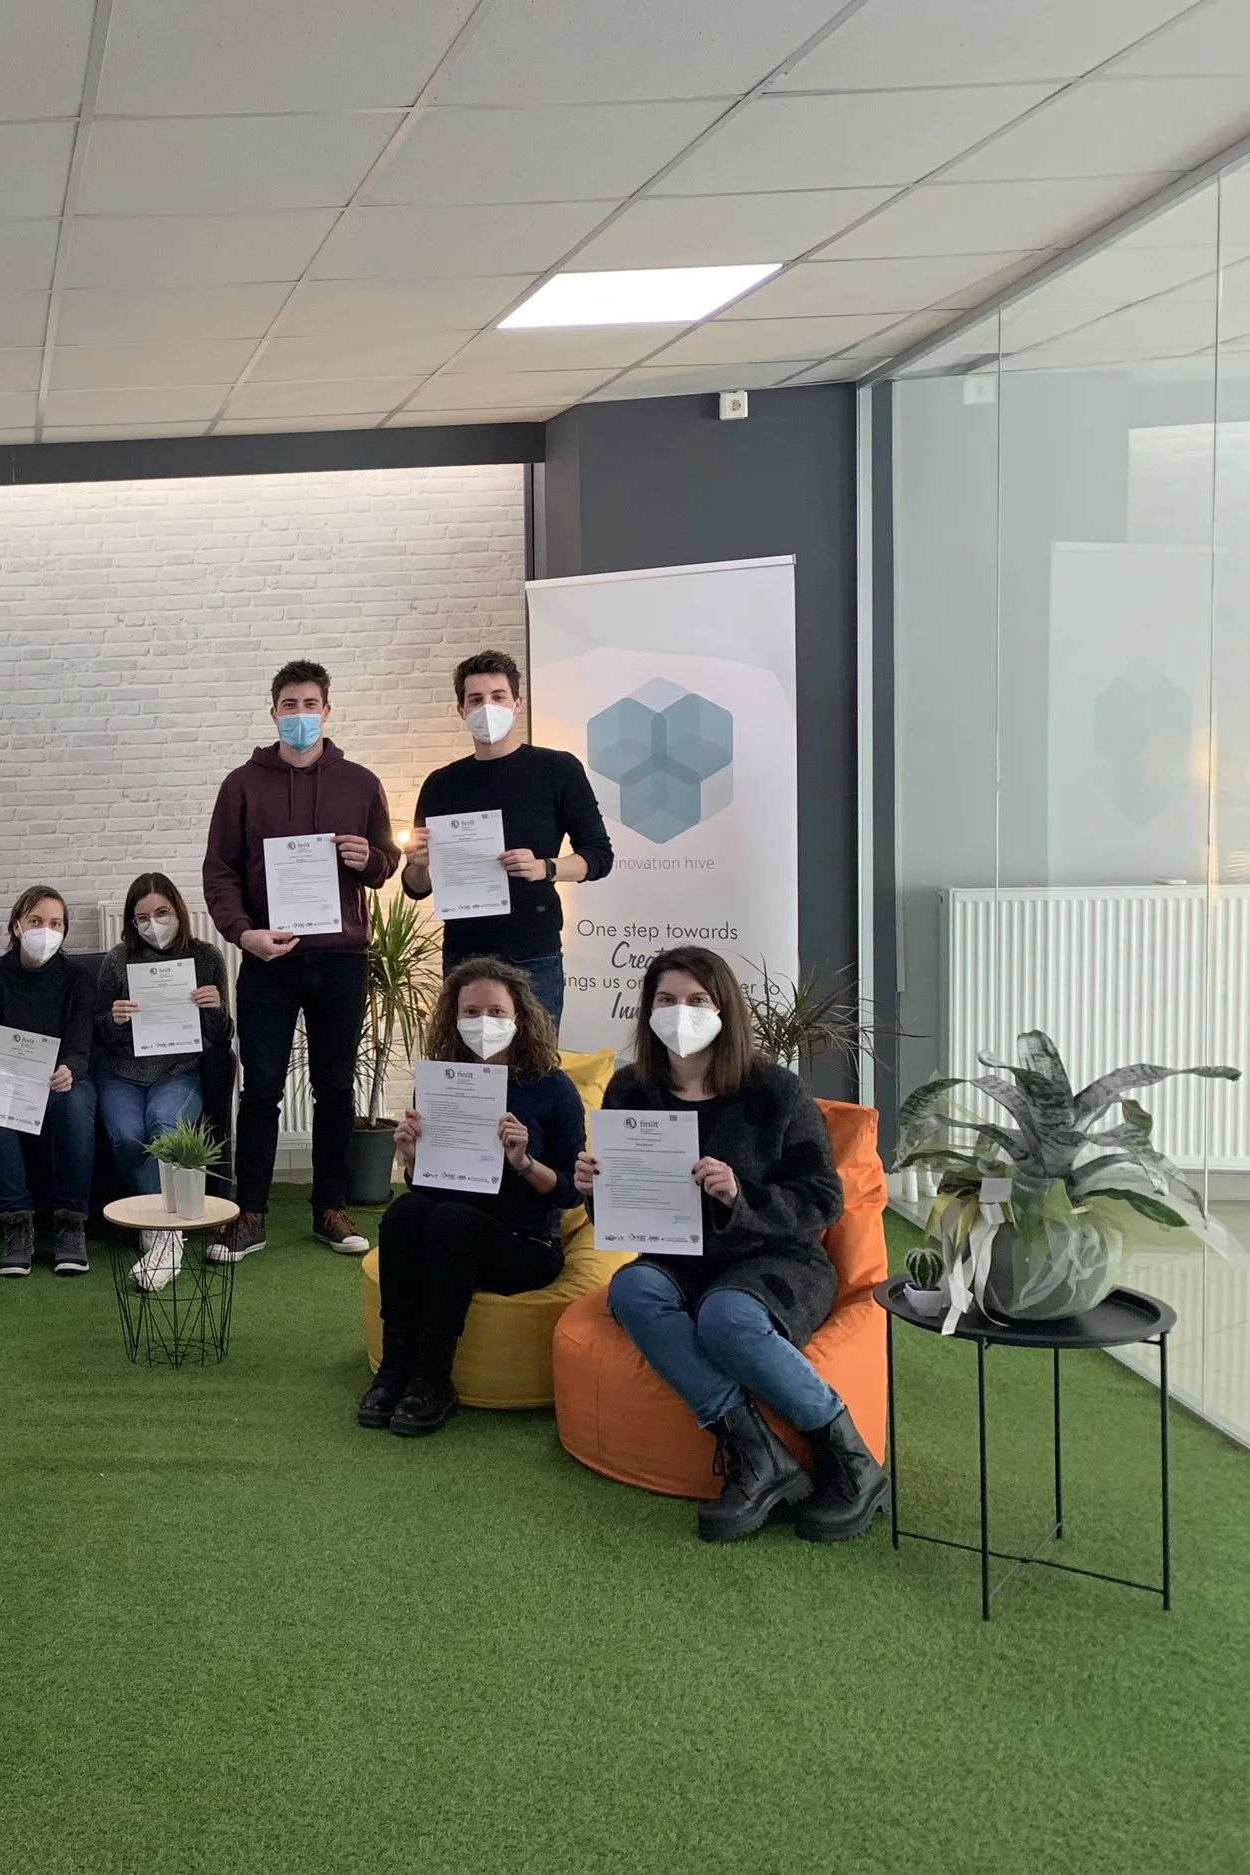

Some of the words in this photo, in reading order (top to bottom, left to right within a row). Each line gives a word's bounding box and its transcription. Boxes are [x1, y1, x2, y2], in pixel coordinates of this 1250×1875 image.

[613, 857, 680, 870] nnovation
[685, 856, 715, 869] hive
[577, 919, 617, 937] One
[623, 923, 659, 942] step
[666, 921, 738, 940] towards
[603, 978, 620, 989] us
